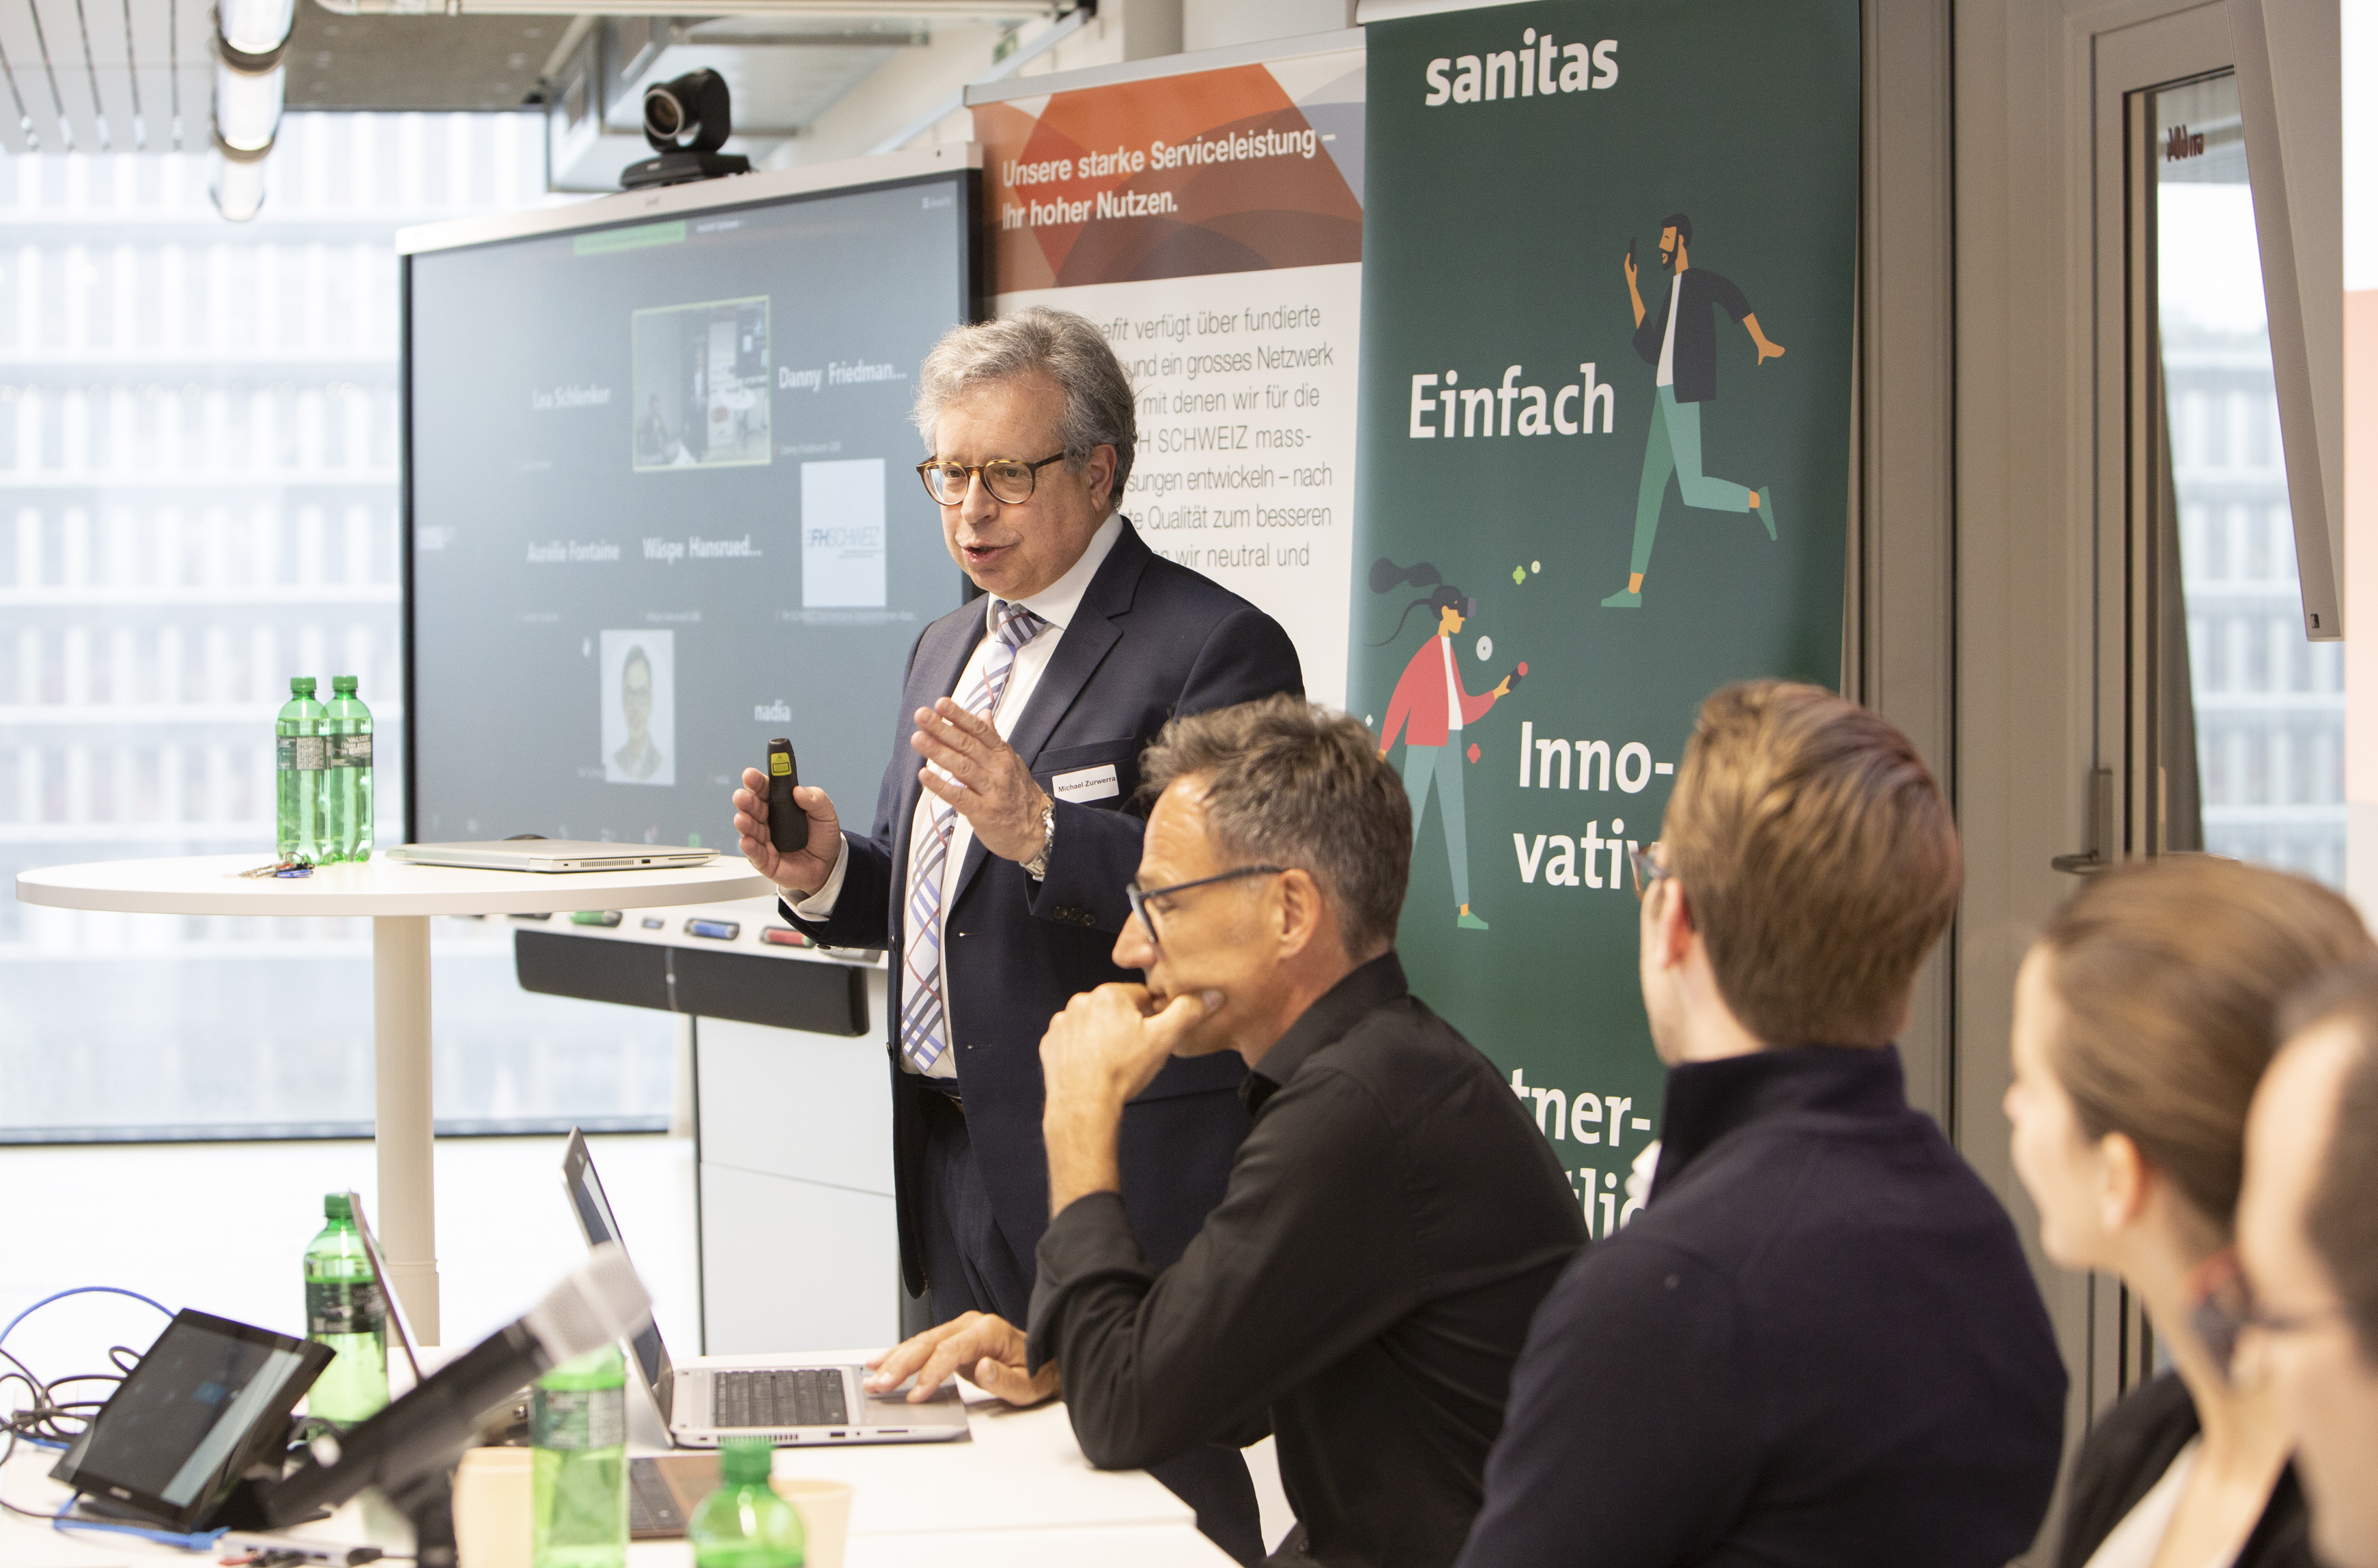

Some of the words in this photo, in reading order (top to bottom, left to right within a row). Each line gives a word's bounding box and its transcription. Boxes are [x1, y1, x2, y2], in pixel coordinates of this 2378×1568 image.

[1425, 27, 1619, 106] sanitas
[1002, 158, 1073, 187] Unsere
[1077, 146, 1145, 178] starke
[1150, 128, 1316, 170] Serviceleistung
[1002, 203, 1027, 230] Ihr
[1030, 198, 1092, 226] hoher
[1096, 190, 1178, 219] Nutzen.
[1101, 317, 1129, 341] efit
[1135, 313, 1191, 343] verfügt
[1197, 310, 1238, 334] über
[1244, 304, 1320, 332] fundierte
[778, 366, 822, 393] Danny
[1161, 353, 1183, 377] ein
[1187, 351, 1252, 380] grosses
[1257, 342, 1335, 371] Netzwerk
[1142, 391, 1167, 416] mit
[1173, 390, 1227, 414] denen
[1232, 386, 1260, 411] wir
[1265, 384, 1288, 410] für
[1294, 382, 1320, 408] die
[1409, 362, 1615, 438] Einfach
[1158, 425, 1248, 453] SCHWEIZ
[1255, 427, 1312, 450] mass-
[1127, 472, 1183, 498] sungen
[1187, 464, 1275, 491] entwickeln
[1293, 461, 1333, 487] nach
[1148, 504, 1208, 531] Qualität
[1213, 508, 1251, 529] zum
[1256, 503, 1333, 528] besseren
[1175, 544, 1201, 567] wir
[1206, 542, 1270, 567] neutral
[1277, 542, 1310, 567] und
[1519, 721, 1674, 794] Inno-
[1058, 782, 1084, 793] Michael
[1085, 776, 1116, 787] Zurwerra
[1508, 1068, 1651, 1147] tner-
